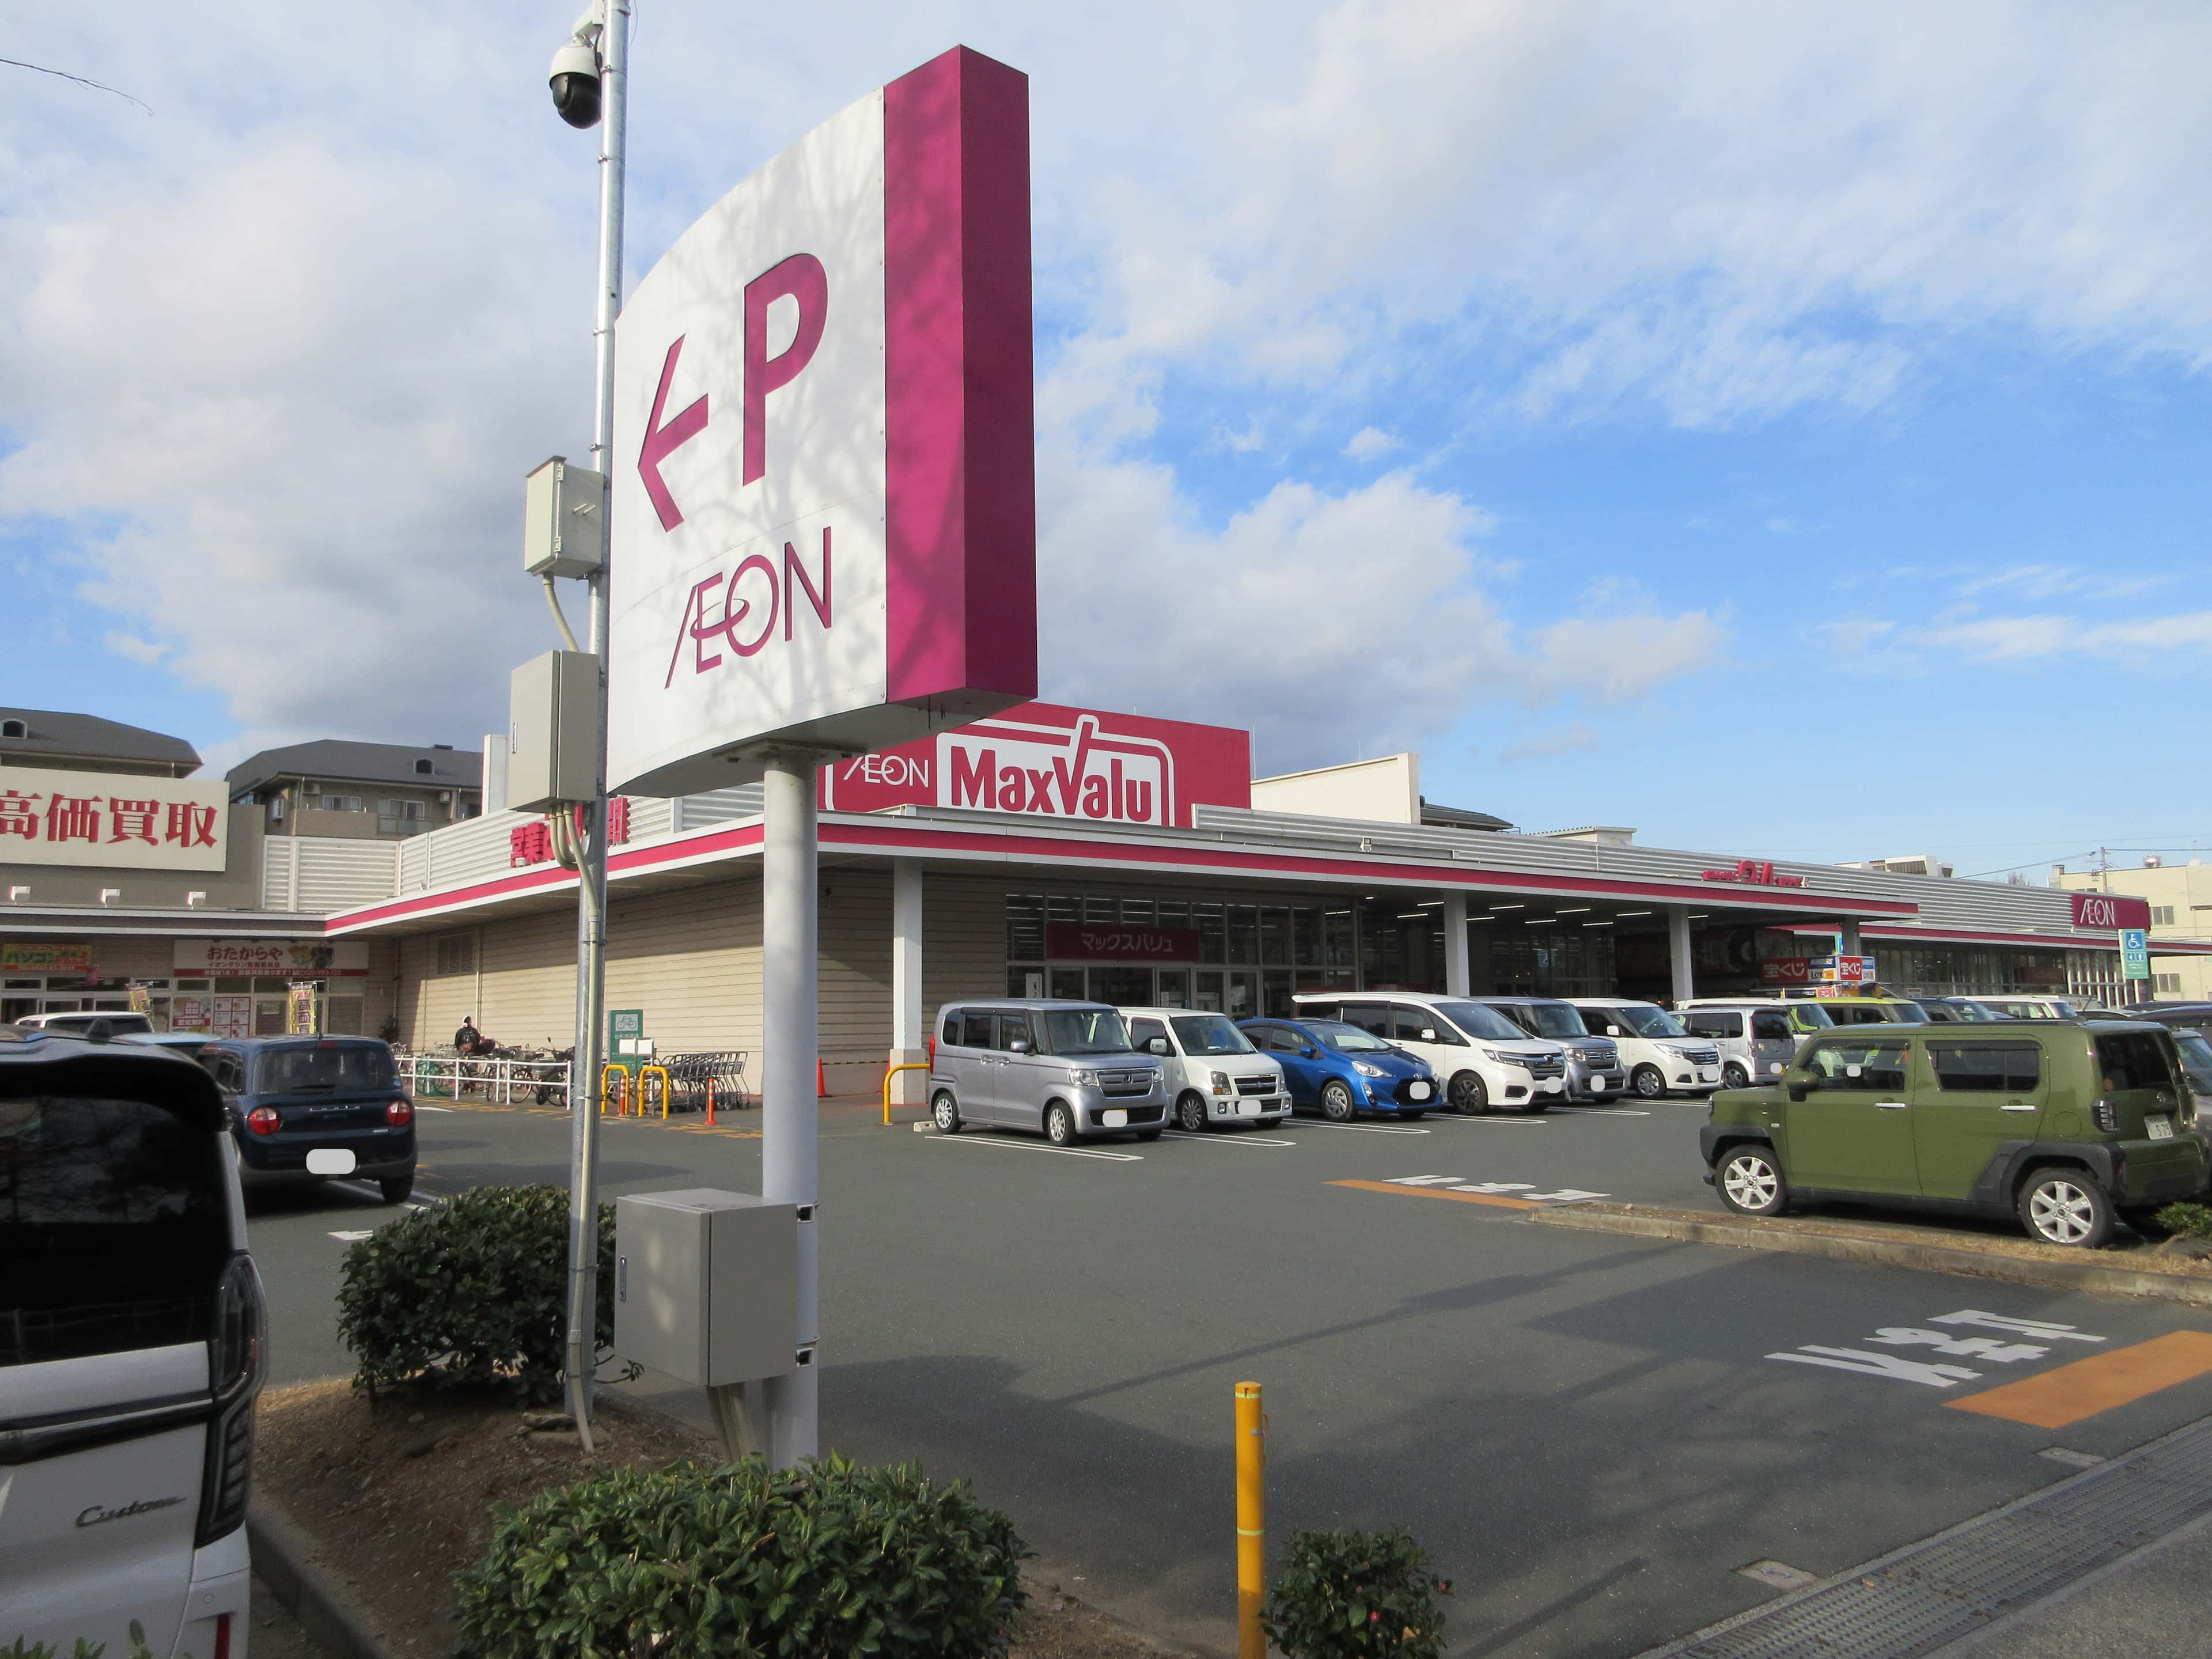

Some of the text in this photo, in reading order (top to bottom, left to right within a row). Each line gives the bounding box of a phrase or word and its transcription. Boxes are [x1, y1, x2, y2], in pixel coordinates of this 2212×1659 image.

[743, 253, 828, 487] P
[951, 721, 1152, 822] MaxValu
[0, 790, 218, 848] 高価買取
[207, 946, 283, 960] おたからや
[1081, 932, 1174, 952] マックスバリュ
[1763, 963, 1805, 977] 宝くじ
[1841, 962, 1861, 975] 宝くじ
[1764, 1309, 2107, 1387] 止まれ
[75, 1497, 188, 1527] Custom
